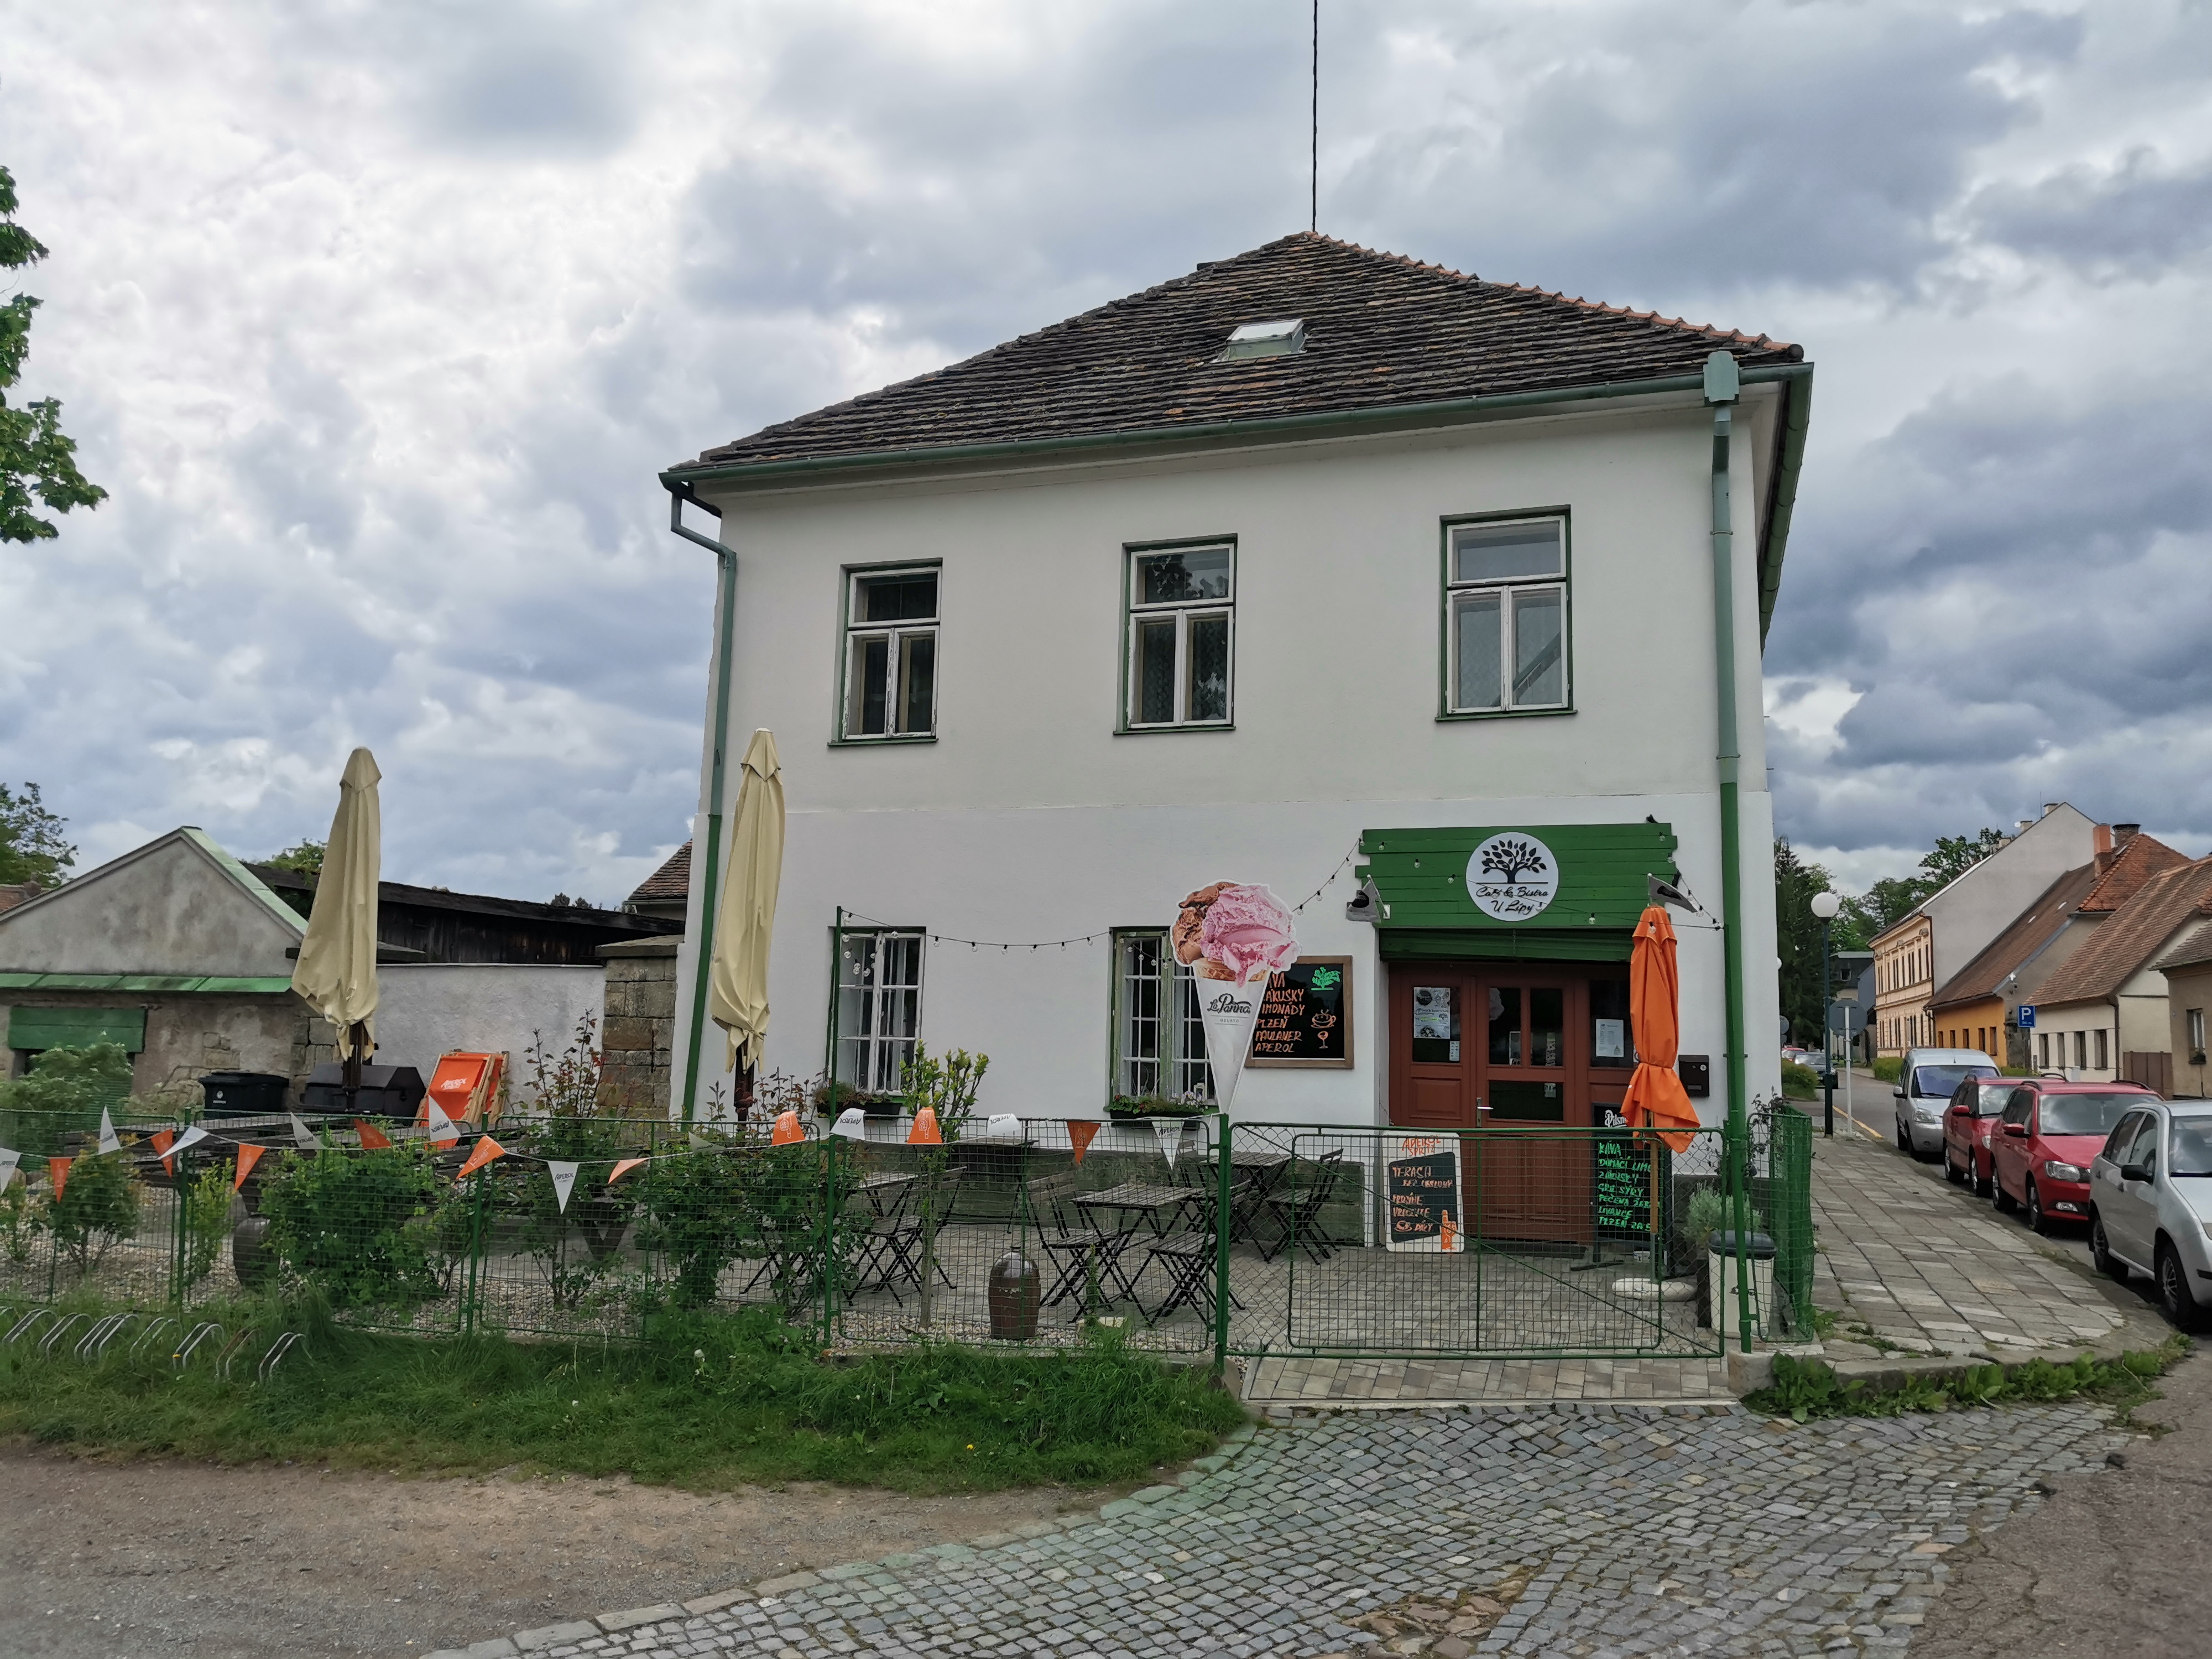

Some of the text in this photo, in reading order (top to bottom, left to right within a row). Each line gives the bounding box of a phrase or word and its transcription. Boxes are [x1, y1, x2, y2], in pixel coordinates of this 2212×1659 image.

[1517, 886, 1549, 897] Bistro
[1491, 900, 1535, 915] U Lípy
[1264, 989, 1304, 1002] ÁKUSKY
[1207, 993, 1252, 1014] La Panna
[1260, 1001, 1305, 1015] IMONÁDY
[2021, 1007, 2031, 1020] P
[1256, 1015, 1290, 1029] PLZEŇ
[1255, 1030, 1302, 1041] PAULANER
[1255, 1042, 1295, 1052] APEROL
[1599, 1140, 1621, 1156] KÁVA
[555, 1172, 574, 1181] APEROL
